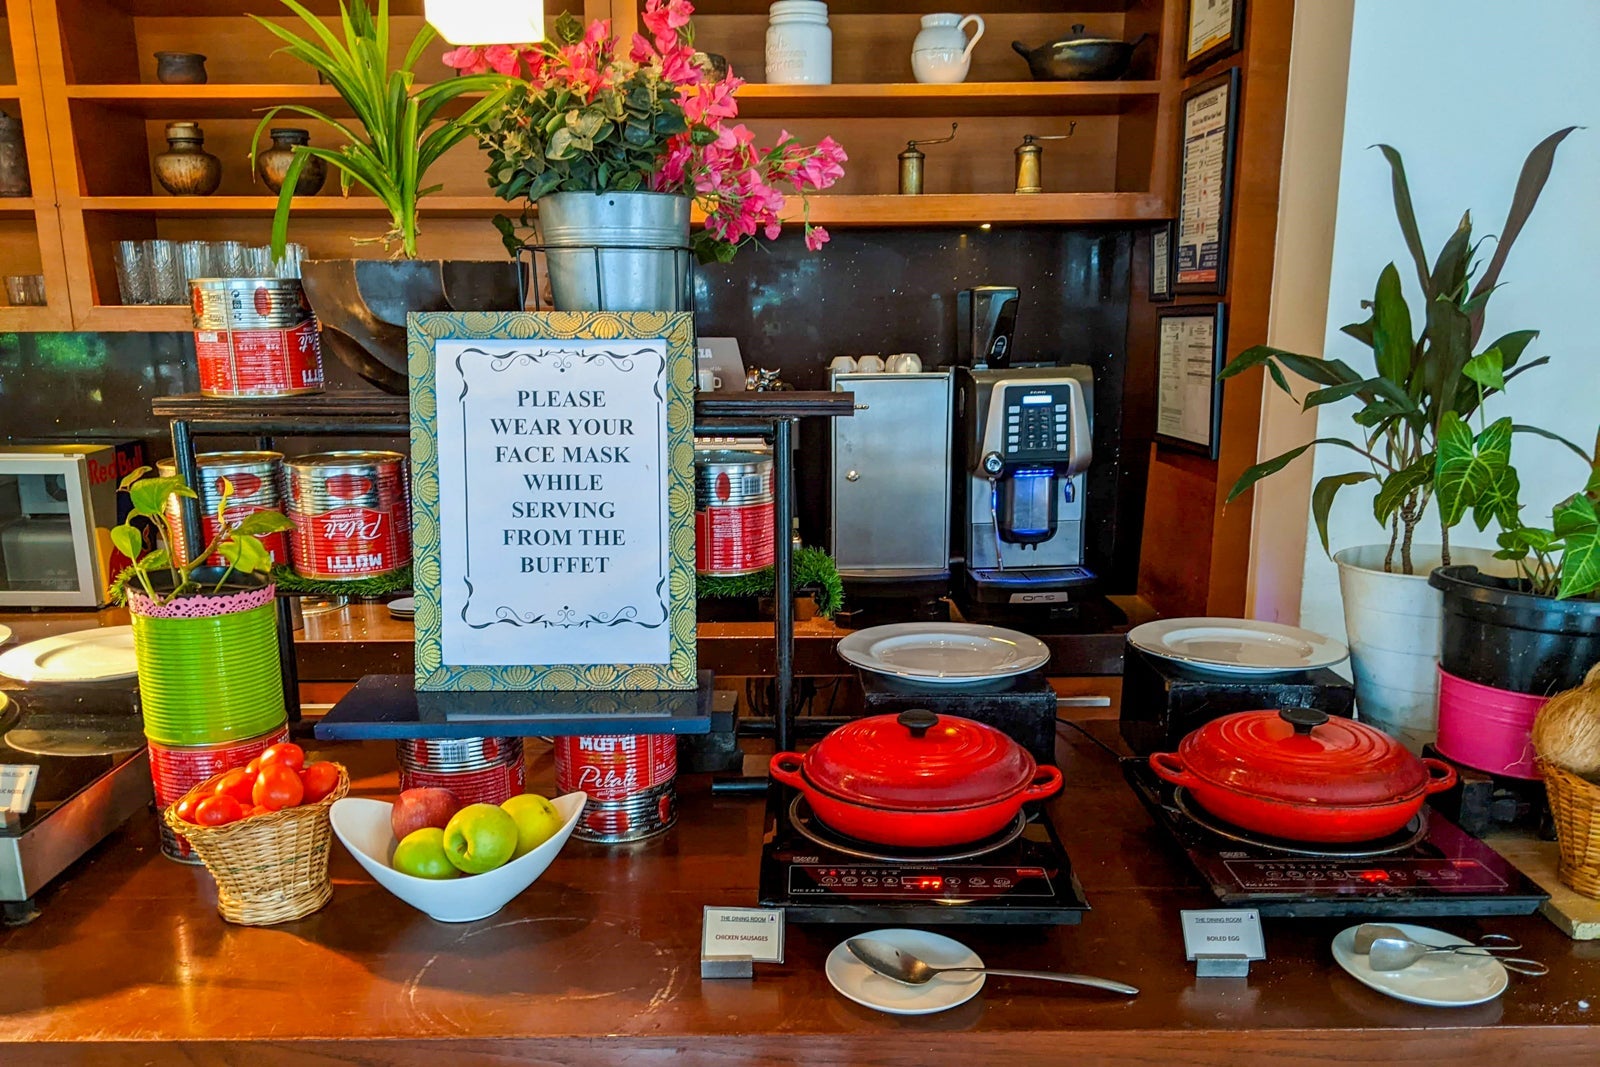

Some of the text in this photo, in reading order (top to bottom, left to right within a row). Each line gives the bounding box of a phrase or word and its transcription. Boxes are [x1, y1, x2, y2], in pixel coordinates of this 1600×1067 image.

[517, 390, 606, 408] PLEASE
[490, 418, 634, 435] WEAR YOUR
[495, 446, 631, 464] FACE MASK
[88, 445, 143, 485] Red Bull
[524, 474, 603, 491] WHILE
[512, 501, 616, 519] SERVING
[324, 514, 381, 539] Pelati
[503, 529, 626, 546] FROM THE
[327, 552, 382, 569] MUTTI
[520, 557, 610, 574] BUFFET
[579, 736, 636, 751] MUTTI
[578, 765, 638, 789] Pelati
